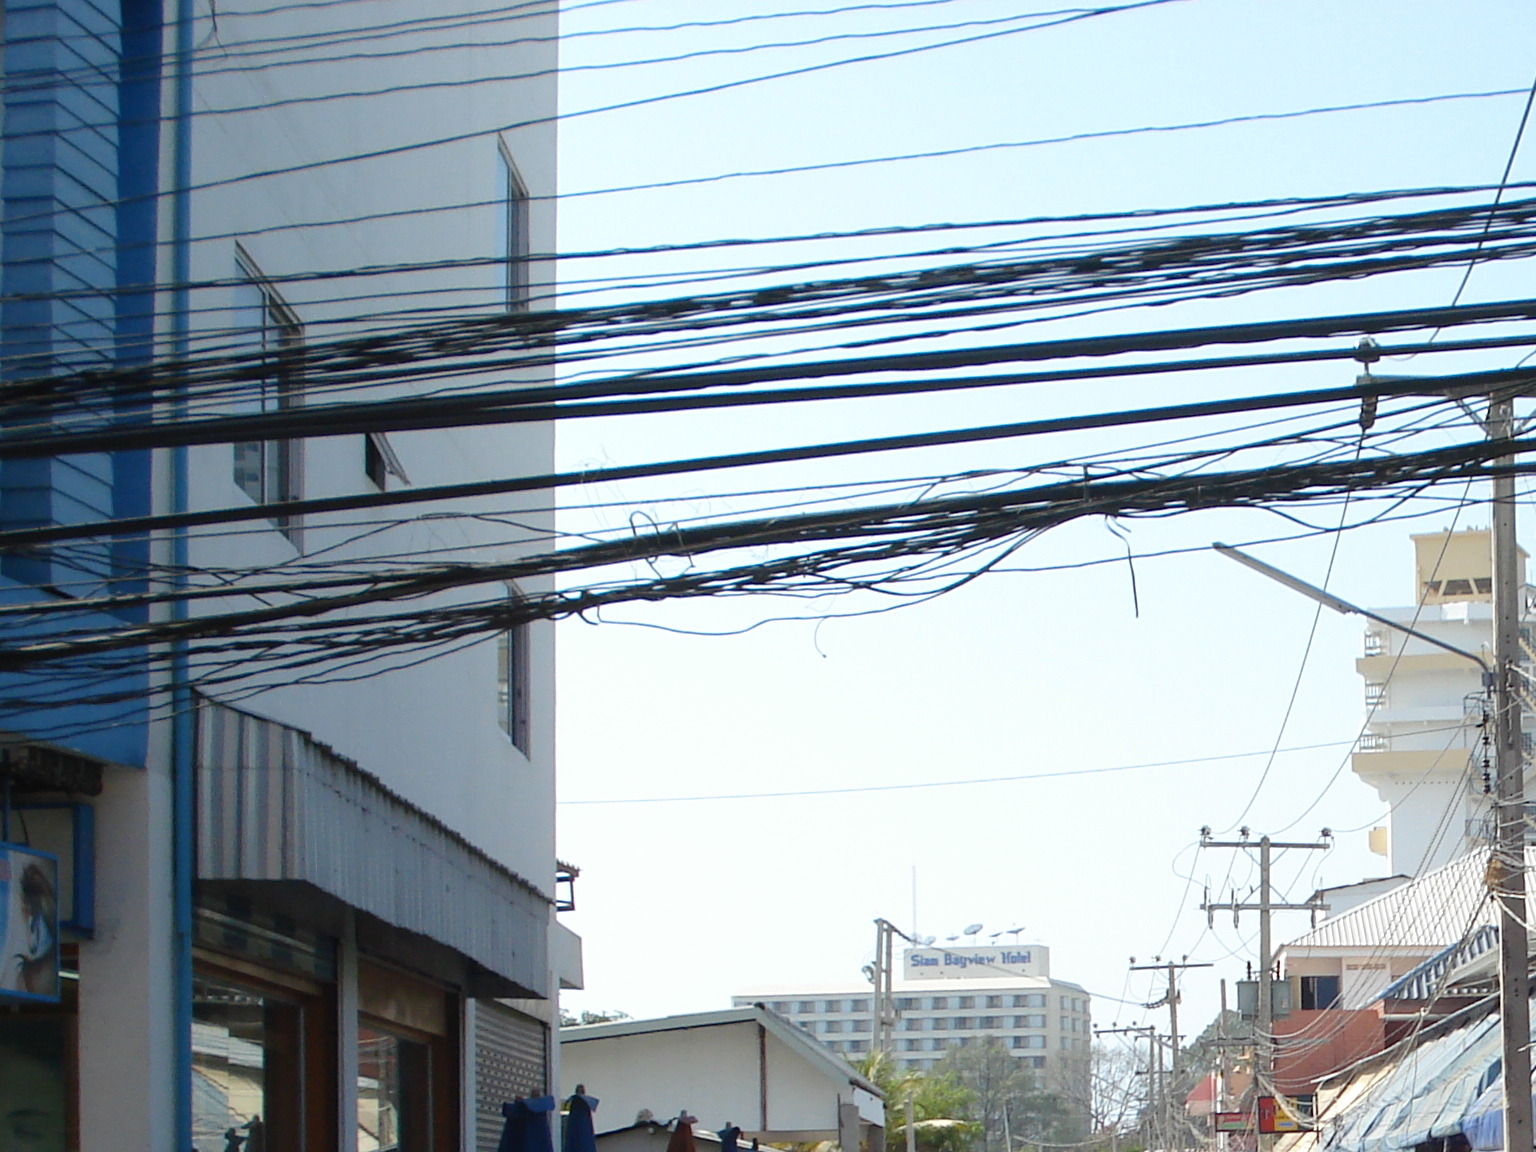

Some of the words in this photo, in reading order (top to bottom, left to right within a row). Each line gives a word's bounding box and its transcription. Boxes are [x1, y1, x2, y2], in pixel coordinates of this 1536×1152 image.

[911, 954, 939, 967] Siam
[944, 953, 996, 968] Bayview
[1001, 951, 1031, 964] Hotel
